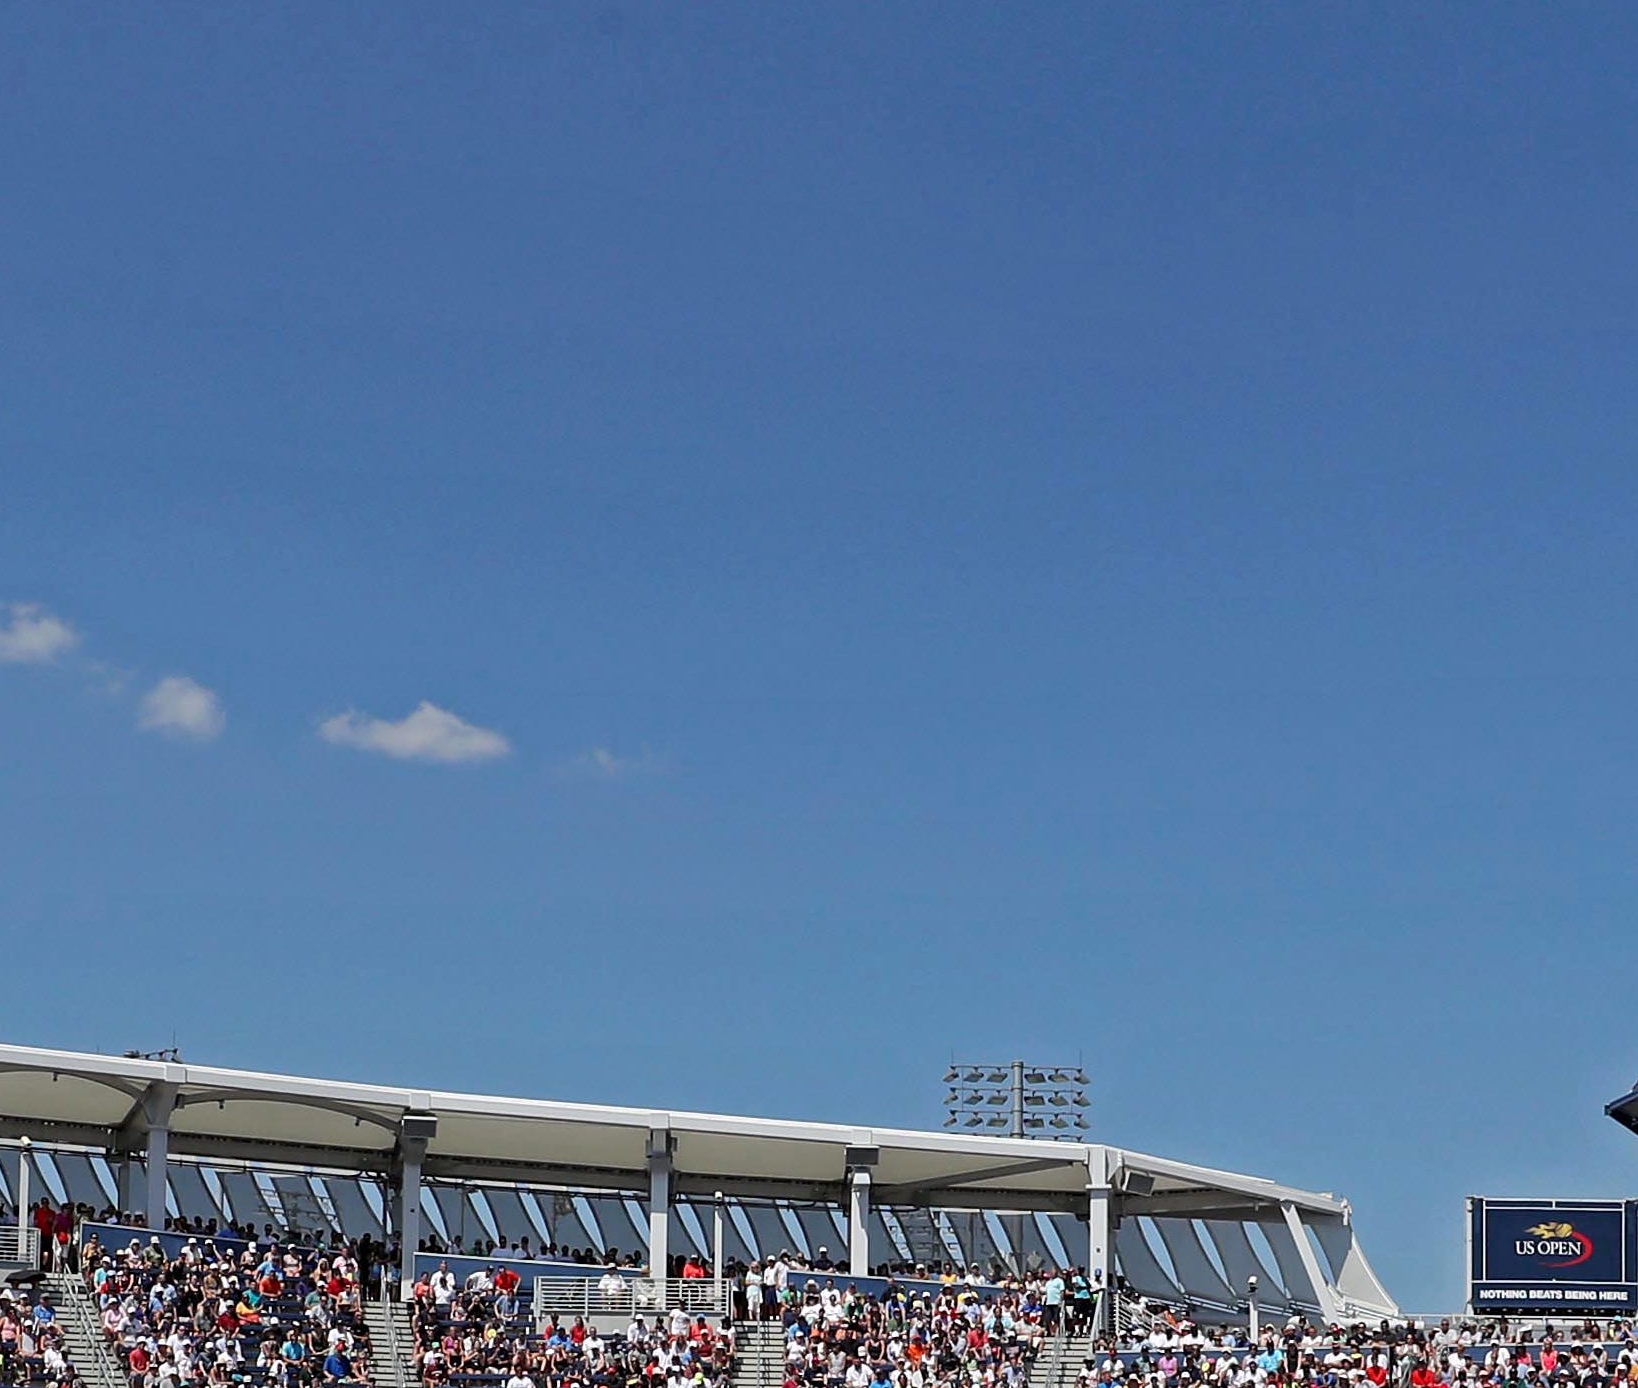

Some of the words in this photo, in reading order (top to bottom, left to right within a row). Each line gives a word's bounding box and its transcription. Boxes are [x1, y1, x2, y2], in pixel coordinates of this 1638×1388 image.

[1515, 1241, 1535, 1255] US
[1537, 1241, 1582, 1256] OPEN
[1479, 1289, 1528, 1299] NOTHING
[1529, 1290, 1563, 1300] BEATS
[1564, 1290, 1597, 1300] BEING
[1598, 1291, 1628, 1301] HERE
